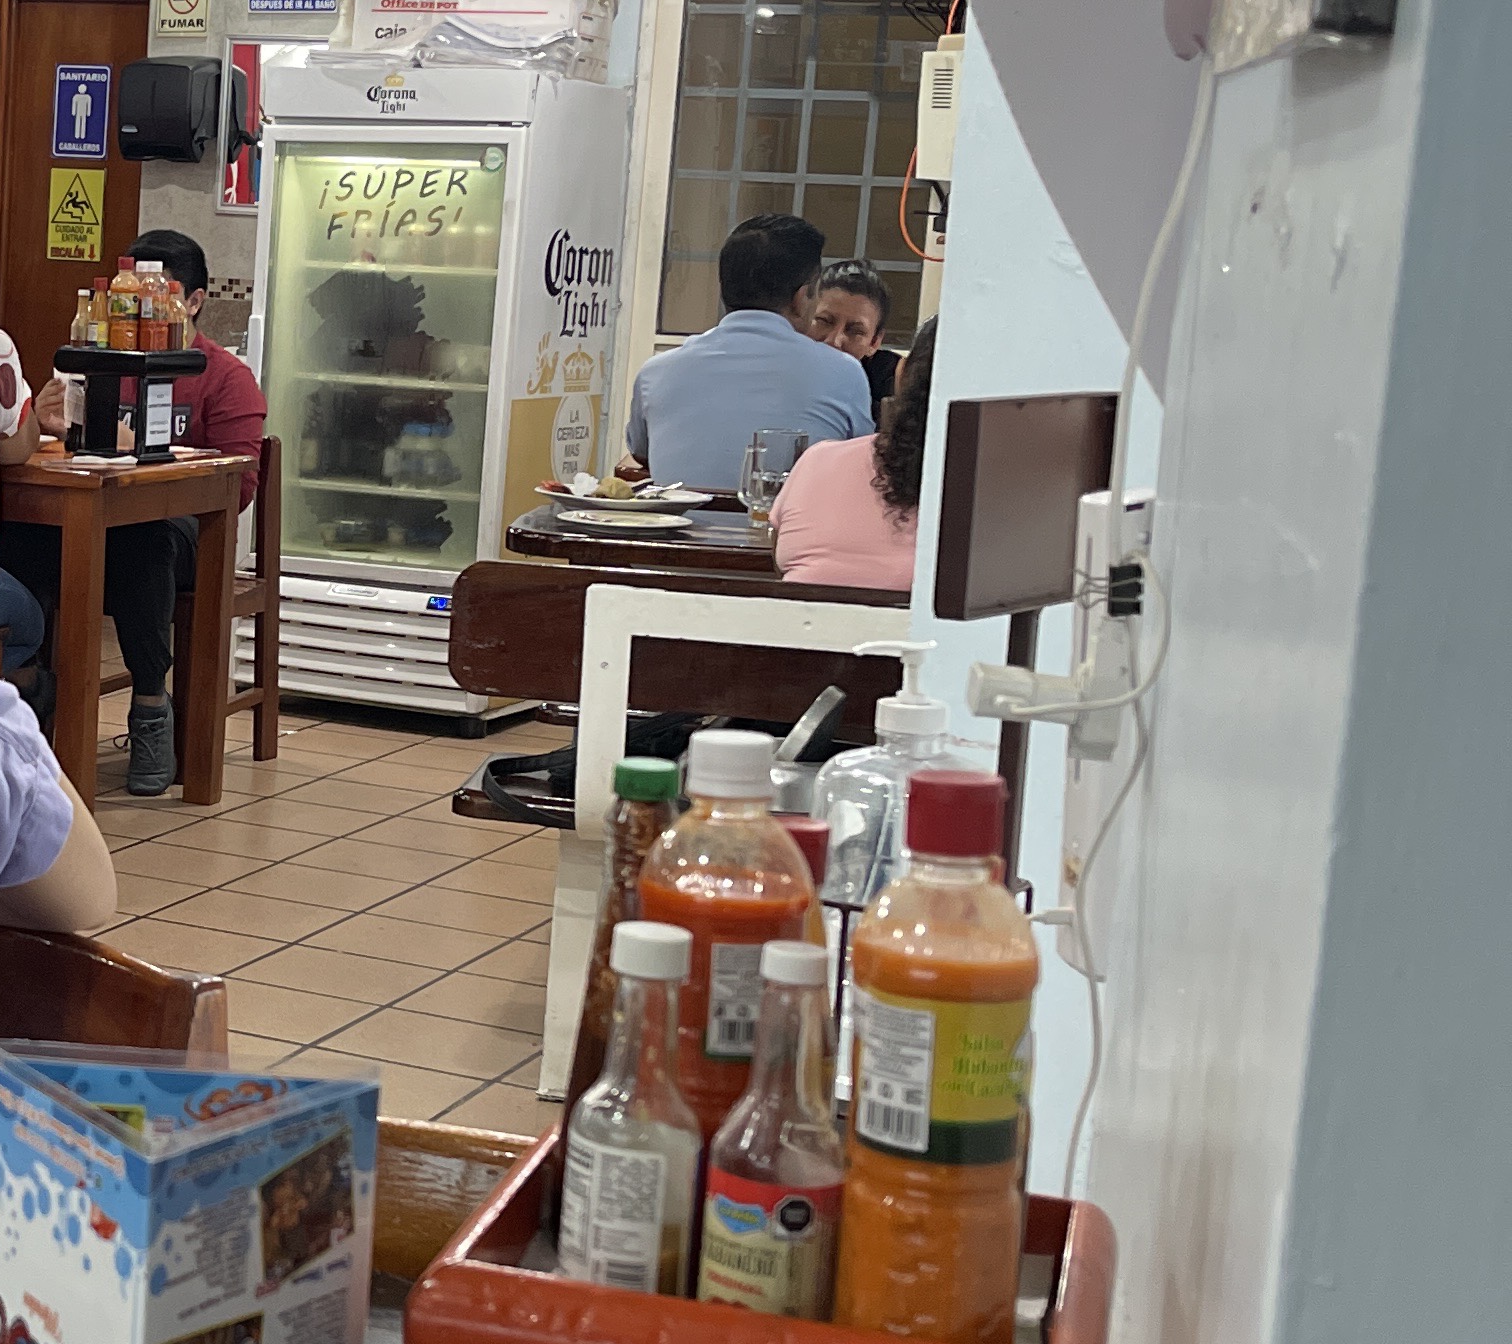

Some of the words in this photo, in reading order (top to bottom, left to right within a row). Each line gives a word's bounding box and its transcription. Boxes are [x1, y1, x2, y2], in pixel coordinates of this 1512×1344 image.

[284, 0, 294, 9] DE
[304, 0, 314, 9] AL
[160, 19, 204, 28] FUMAR
[60, 72, 107, 82] SANITARIO
[367, 86, 416, 103] Corona
[379, 101, 406, 114] Light
[58, 142, 100, 152] CABALLEROS
[55, 225, 84, 234] CUIDADO
[86, 227, 94, 235] AL
[569, 410, 580, 423] LA
[556, 427, 589, 441] CERVEZA
